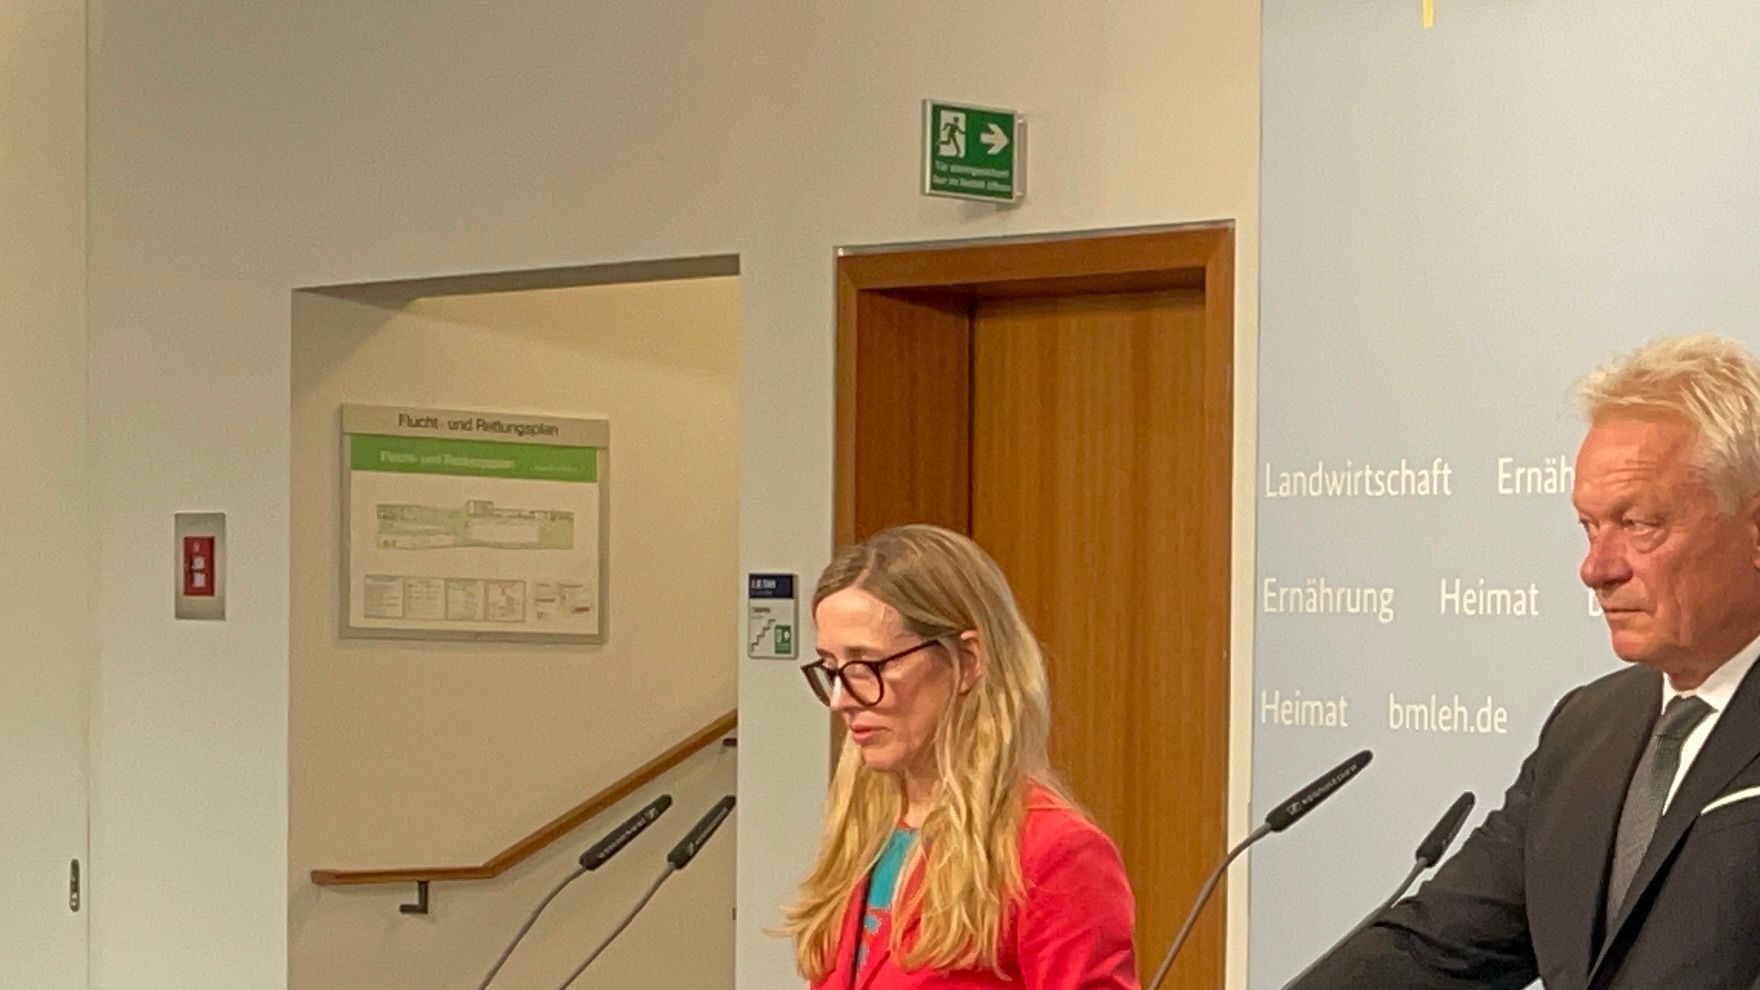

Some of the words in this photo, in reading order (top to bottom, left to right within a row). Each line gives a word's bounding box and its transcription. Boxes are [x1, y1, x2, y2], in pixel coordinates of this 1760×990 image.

[447, 418, 473, 432] und
[476, 418, 560, 437] Rettungsplan
[1265, 457, 1453, 498] Landwirtschaft
[1263, 577, 1395, 623] Ernährung
[1441, 578, 1540, 617] Heimat
[1261, 690, 1349, 728] Heimat
[1389, 693, 1508, 734] bmleh.de
